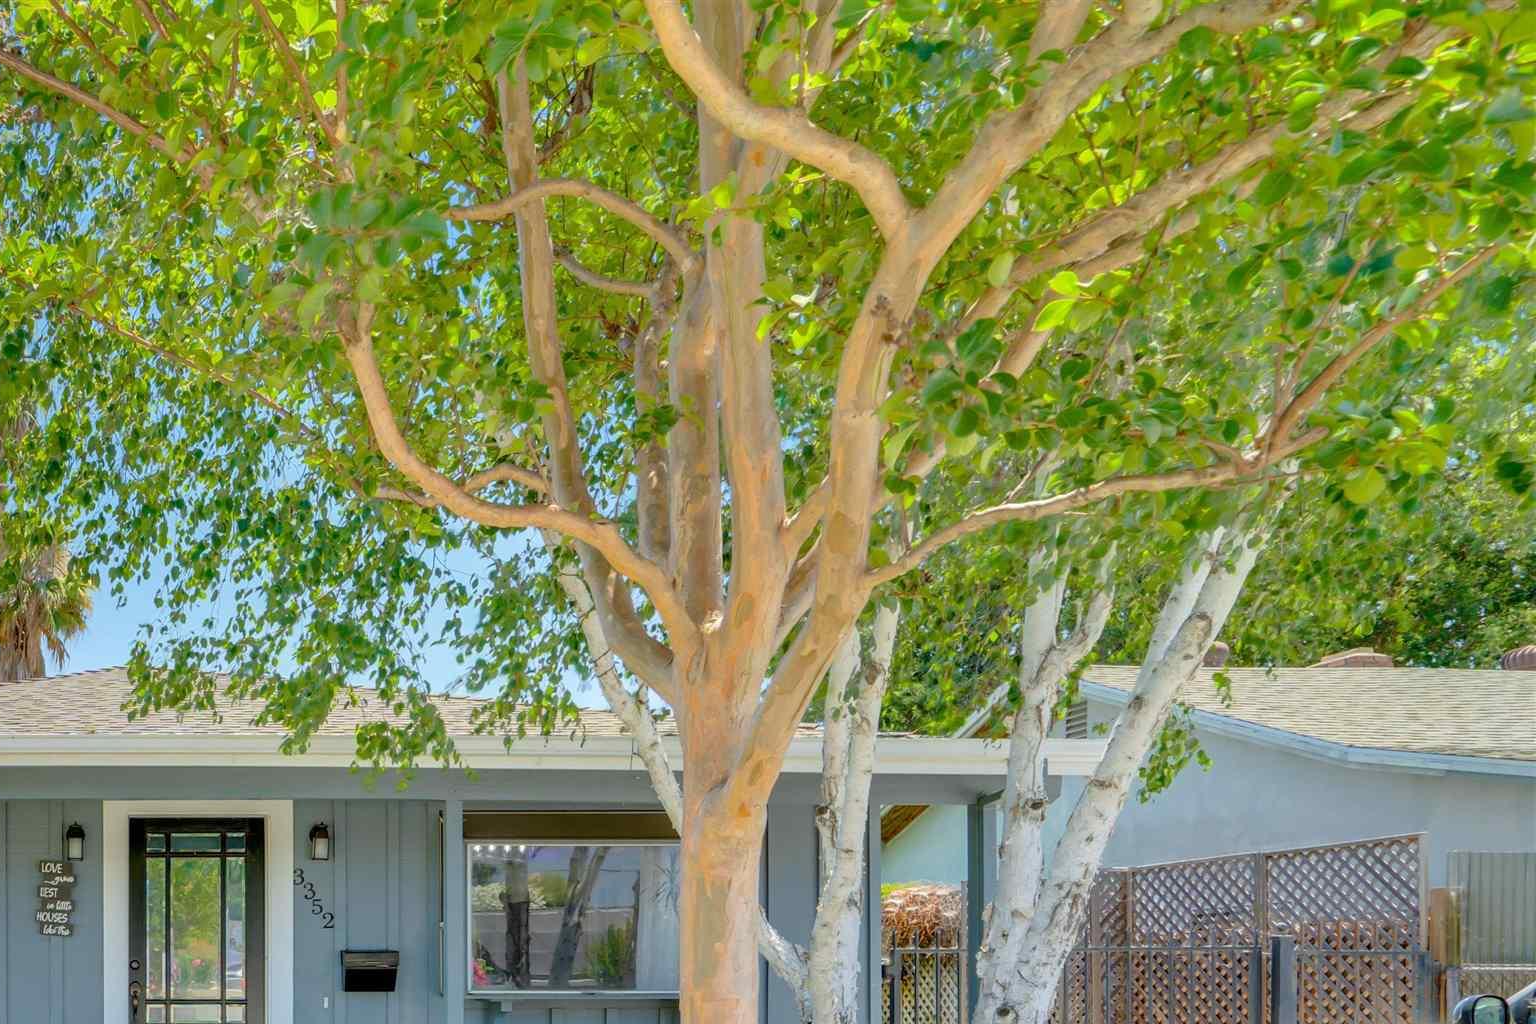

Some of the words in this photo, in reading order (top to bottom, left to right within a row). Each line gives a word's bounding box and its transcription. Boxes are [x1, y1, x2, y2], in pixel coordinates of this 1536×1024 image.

[41, 862, 63, 874] LOVE
[293, 868, 335, 929] 3352
[36, 911, 68, 923] HOUSES
